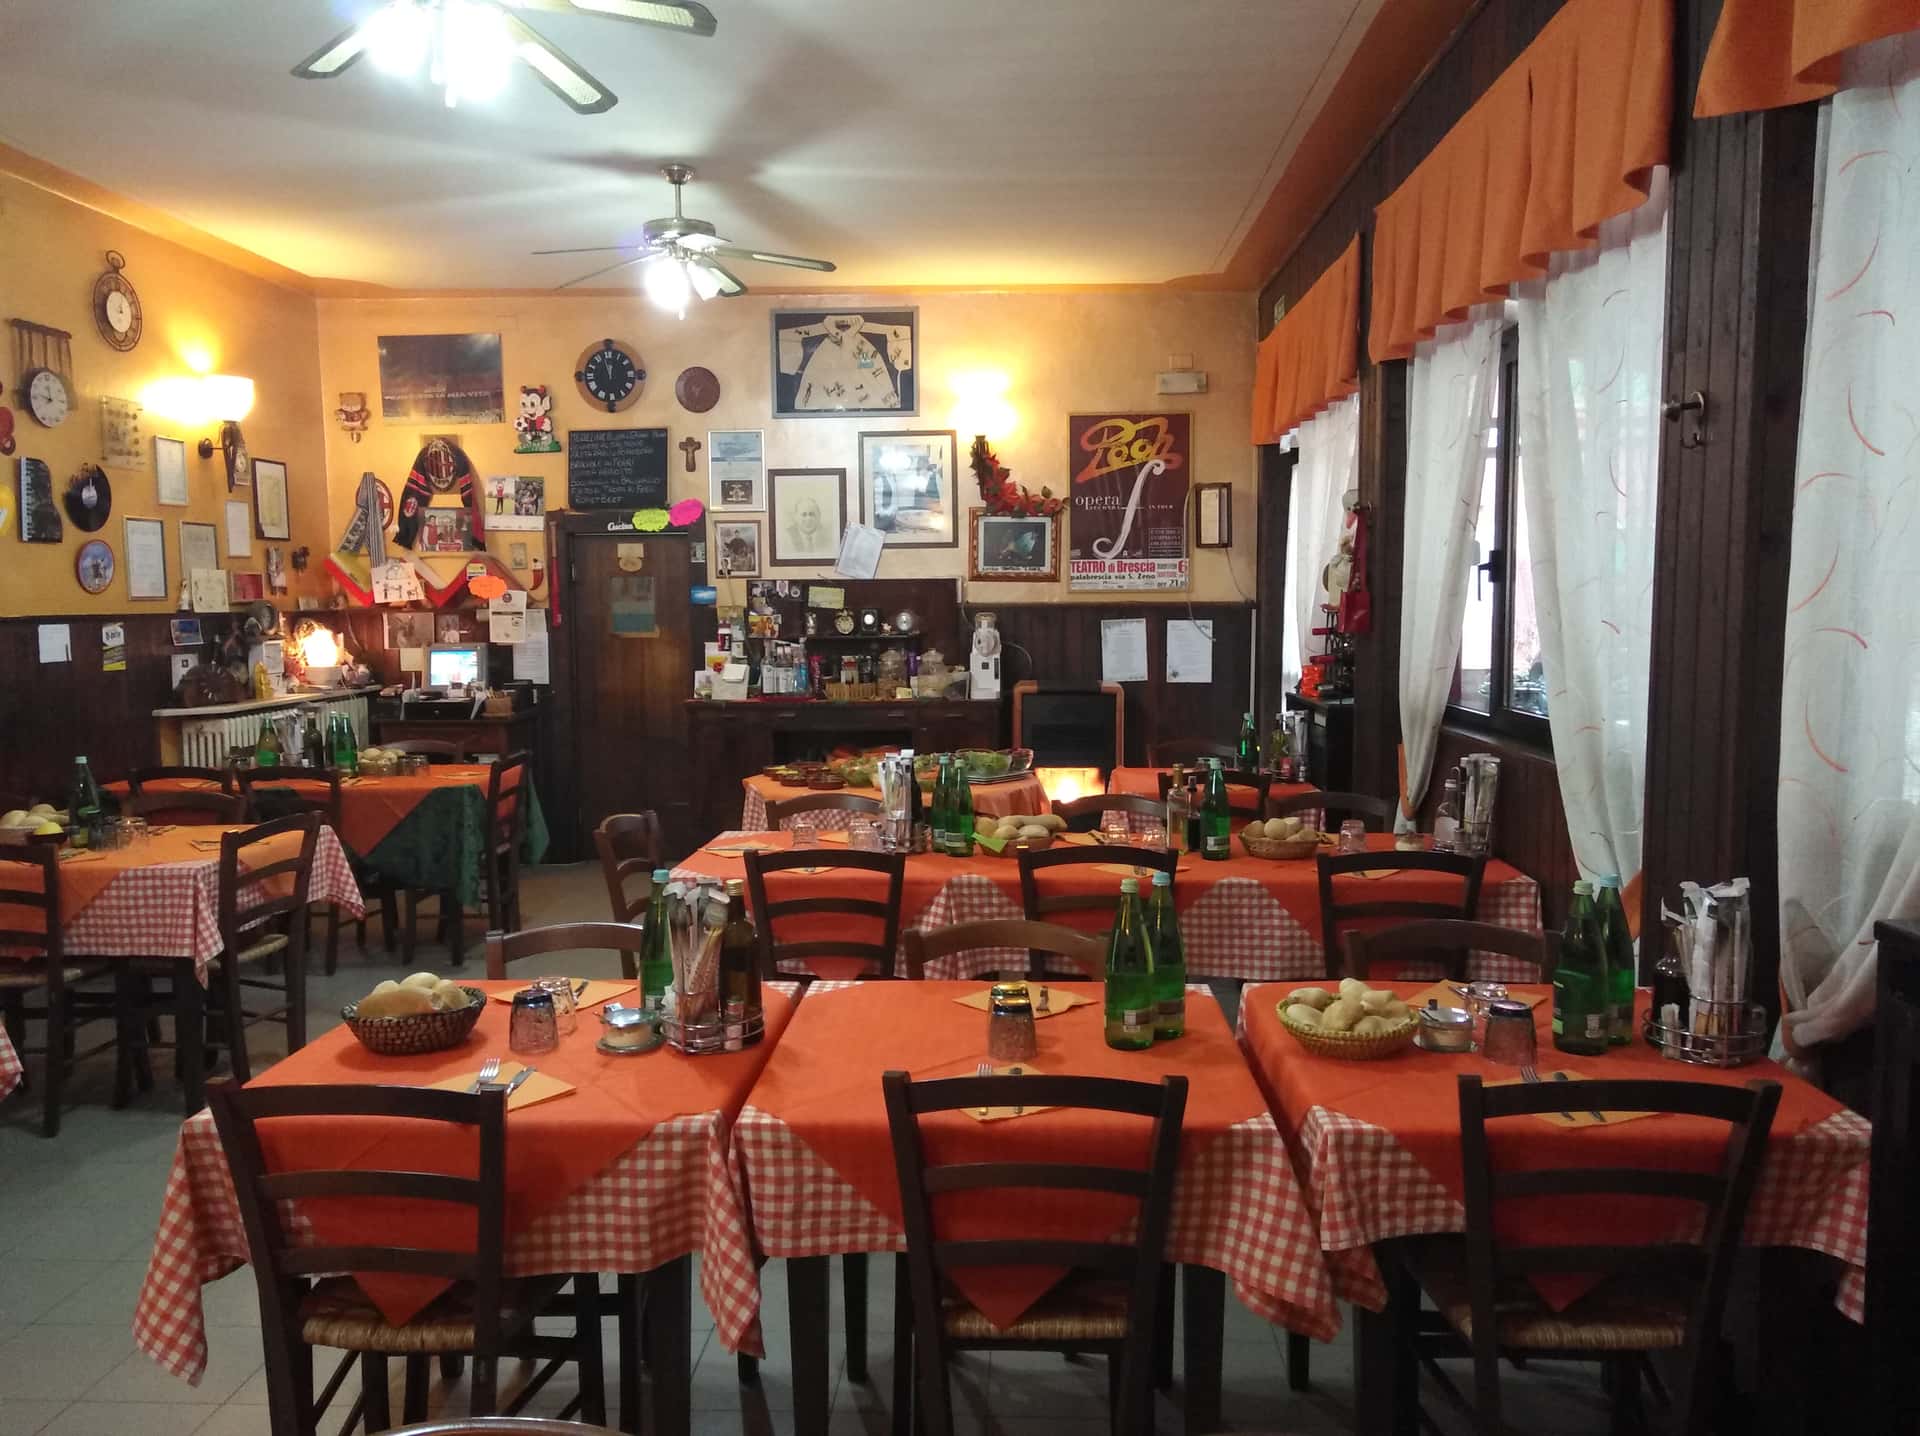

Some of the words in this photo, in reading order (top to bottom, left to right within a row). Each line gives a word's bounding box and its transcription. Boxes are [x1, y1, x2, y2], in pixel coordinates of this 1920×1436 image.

[1075, 495, 1120, 511] opera
[1071, 561, 1106, 573] TEATRO
[1108, 563, 1115, 573] di
[1117, 560, 1156, 573] Brescia
[1070, 573, 1112, 581] palabrescia
[1138, 572, 1156, 580] Zeno
